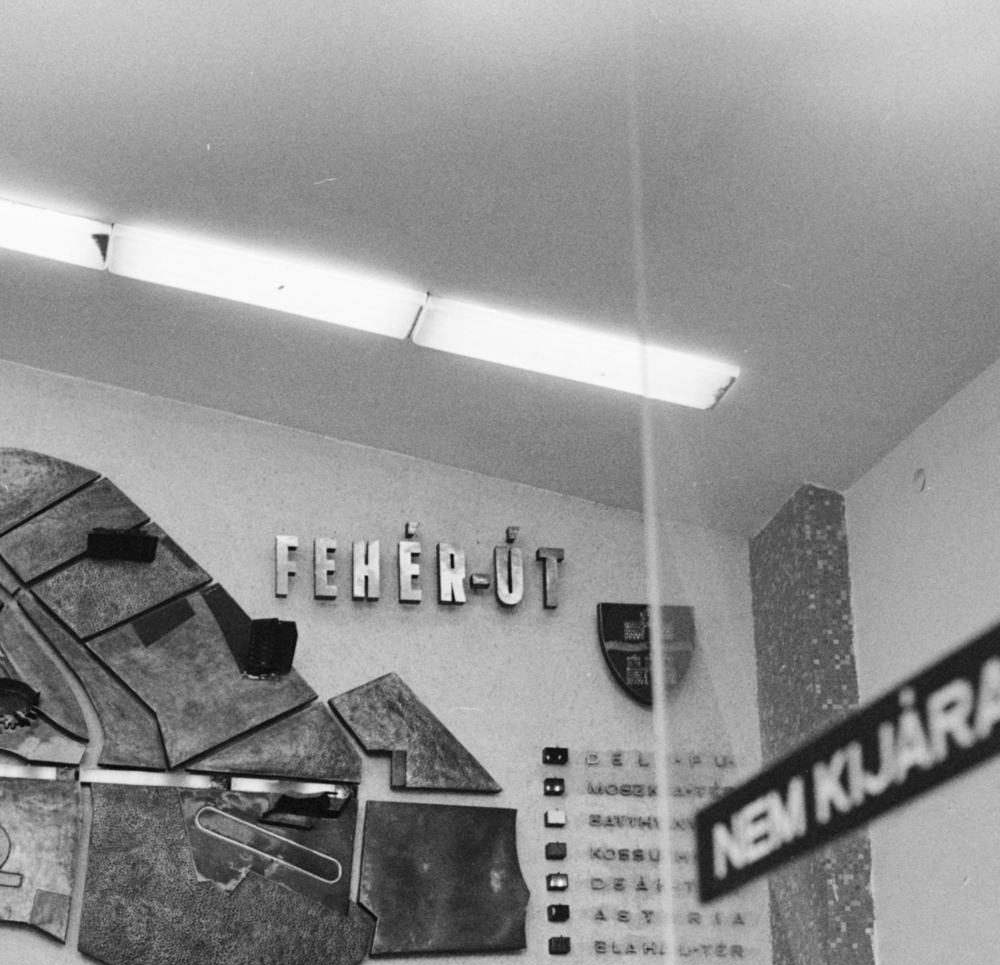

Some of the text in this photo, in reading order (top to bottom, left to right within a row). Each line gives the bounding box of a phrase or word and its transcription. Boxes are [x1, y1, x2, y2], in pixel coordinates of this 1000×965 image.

[275, 521, 565, 610] FEHÉR-ÚT
[712, 775, 807, 880] NEM
[594, 908, 746, 926] ASTRIA
